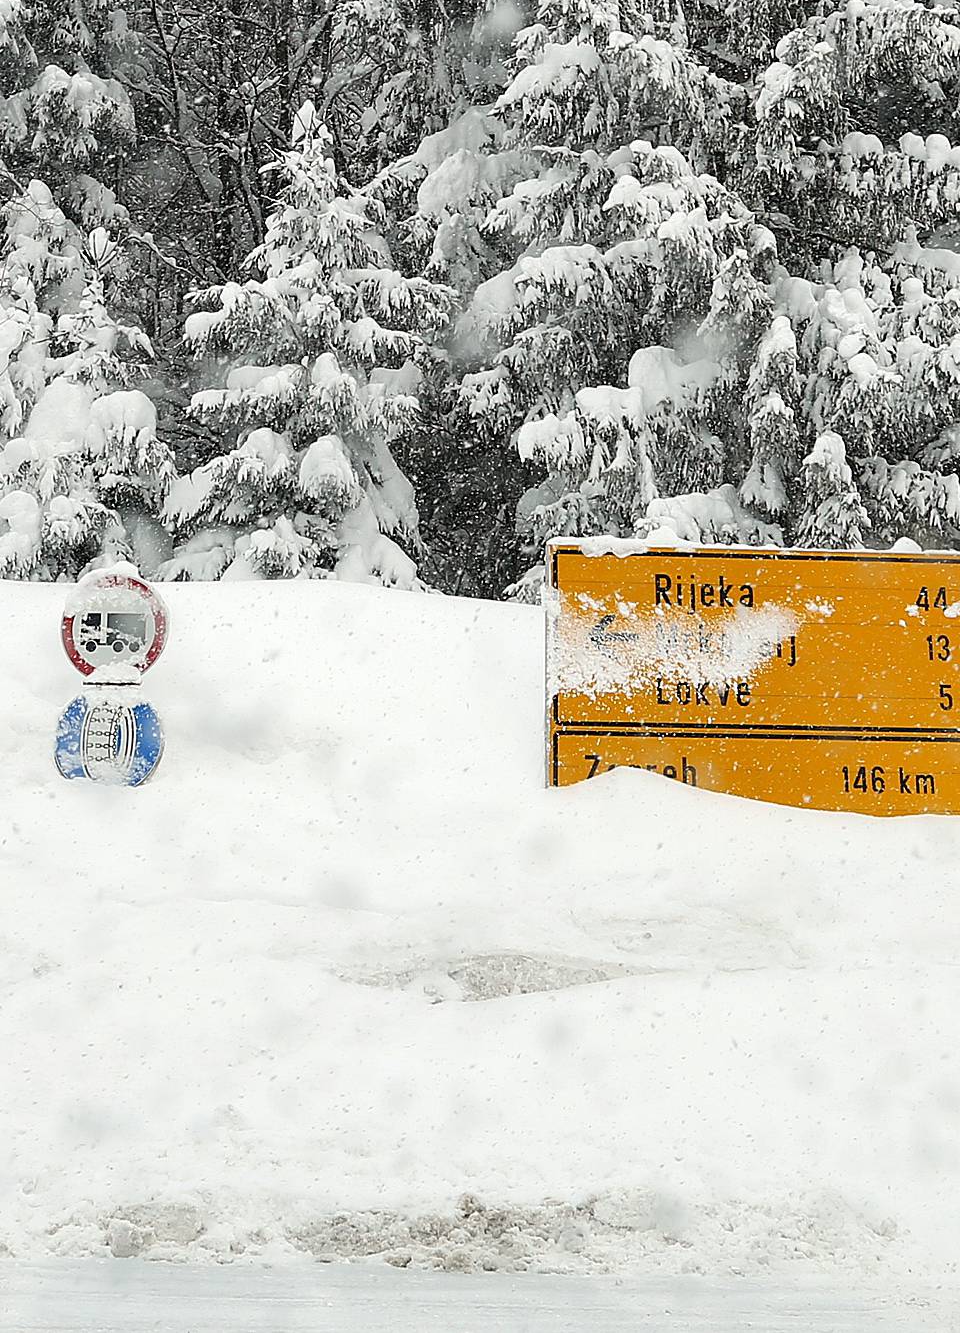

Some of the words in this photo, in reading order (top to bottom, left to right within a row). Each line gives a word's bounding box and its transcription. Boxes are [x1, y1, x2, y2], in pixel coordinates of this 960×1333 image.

[654, 573, 754, 614] Rijeka
[916, 585, 947, 611] 44
[926, 635, 951, 661] 13
[656, 676, 751, 706] Lokve
[938, 684, 954, 711] 5
[841, 765, 886, 794] 146
[898, 767, 936, 794] km
